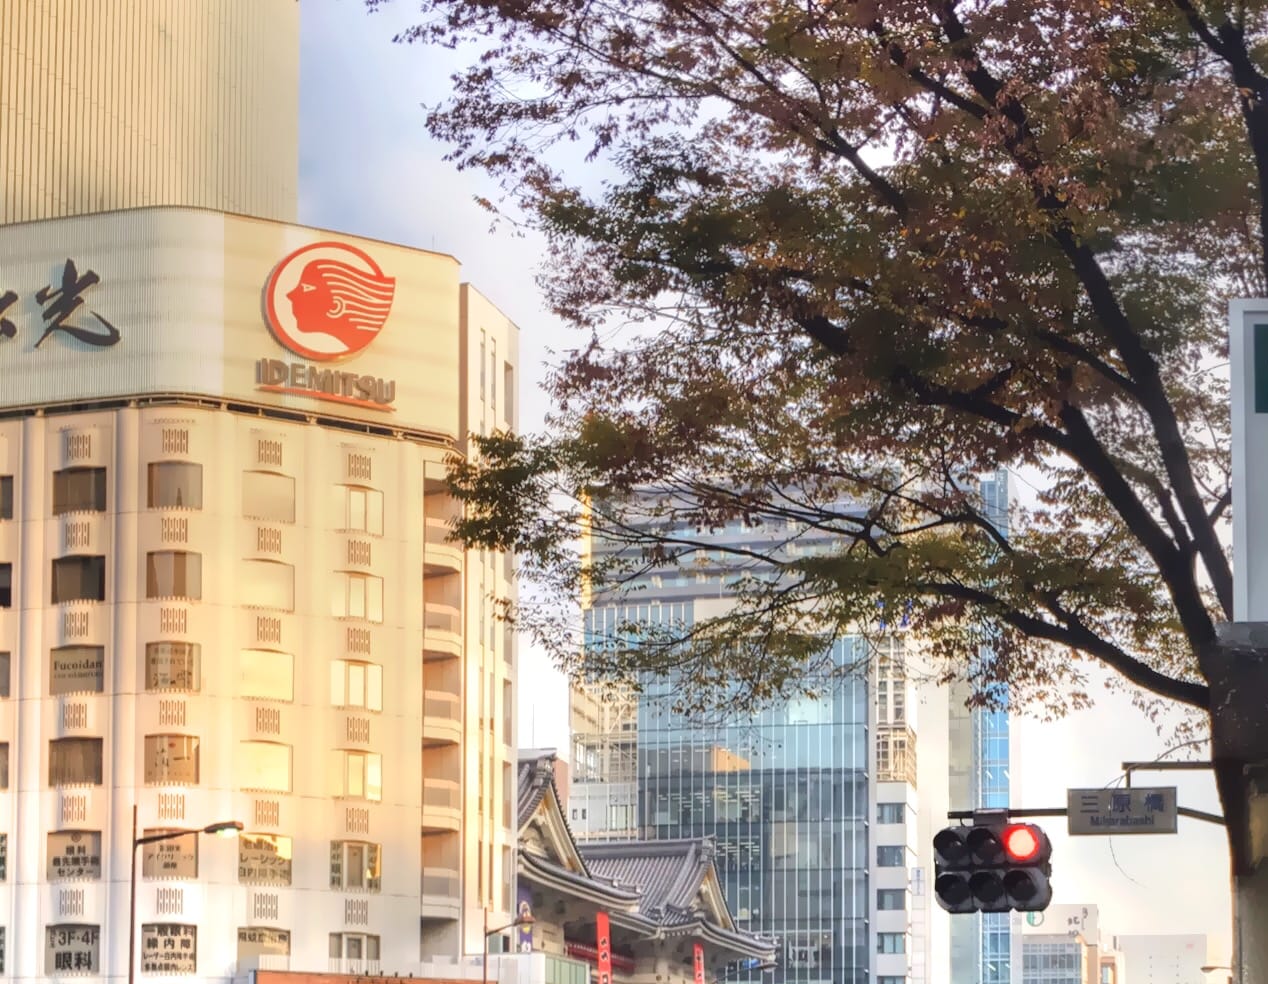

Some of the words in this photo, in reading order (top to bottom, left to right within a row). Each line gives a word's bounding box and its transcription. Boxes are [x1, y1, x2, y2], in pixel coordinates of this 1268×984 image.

[256, 358, 396, 405] IDEMITSU
[1080, 793, 1164, 813] 三原橋
[55, 951, 92, 971] 眼科
